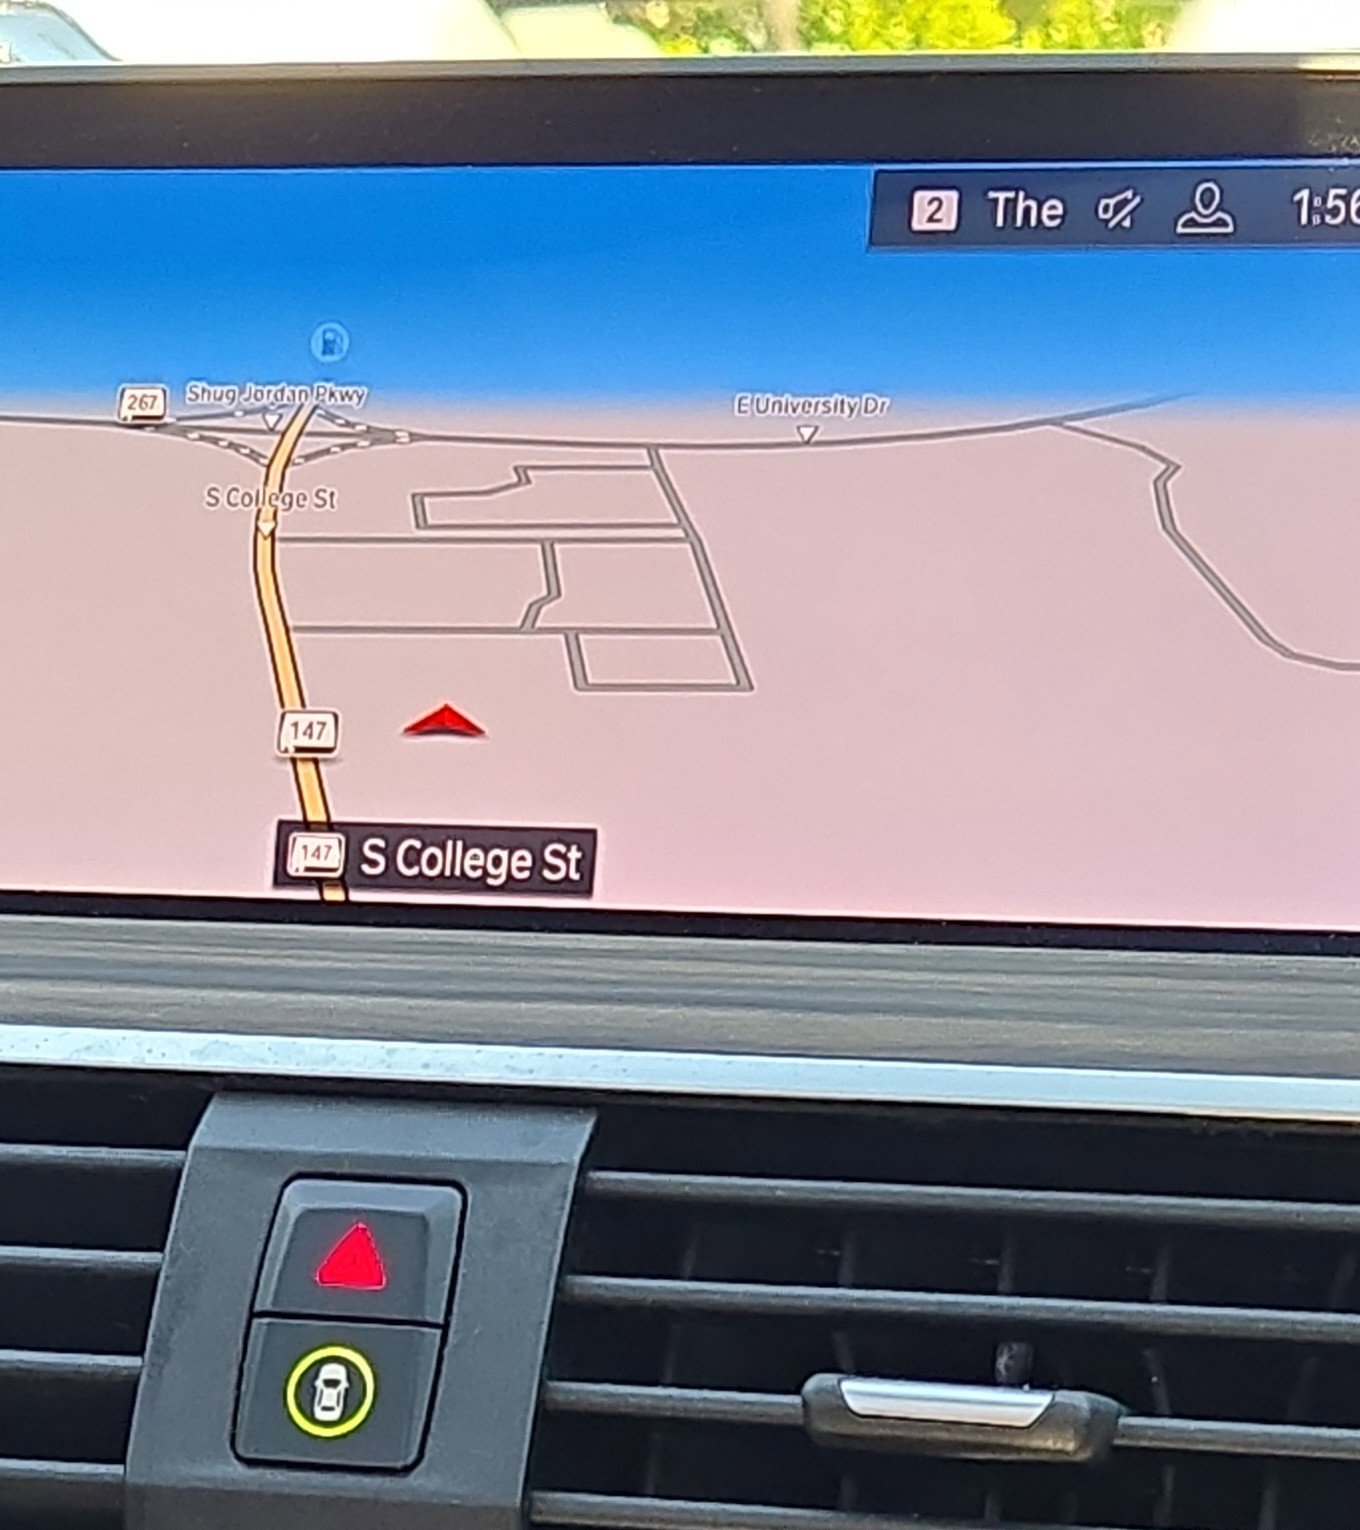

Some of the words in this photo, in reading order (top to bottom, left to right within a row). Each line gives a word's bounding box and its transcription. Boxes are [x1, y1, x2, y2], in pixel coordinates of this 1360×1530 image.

[925, 196, 944, 225] 2
[986, 191, 1064, 228] The
[127, 394, 158, 411] 267
[187, 384, 236, 405] Shug
[242, 384, 308, 403] Jordan
[315, 385, 367, 406] Pkwy
[737, 395, 750, 414] E
[755, 394, 857, 418] University
[863, 396, 888, 416] Dr
[206, 487, 220, 508] S
[226, 487, 308, 511] College
[314, 488, 337, 509] St
[289, 721, 327, 742] 147
[301, 844, 332, 861] 147
[360, 837, 386, 876] S
[396, 839, 533, 887] College
[542, 843, 582, 881] St
